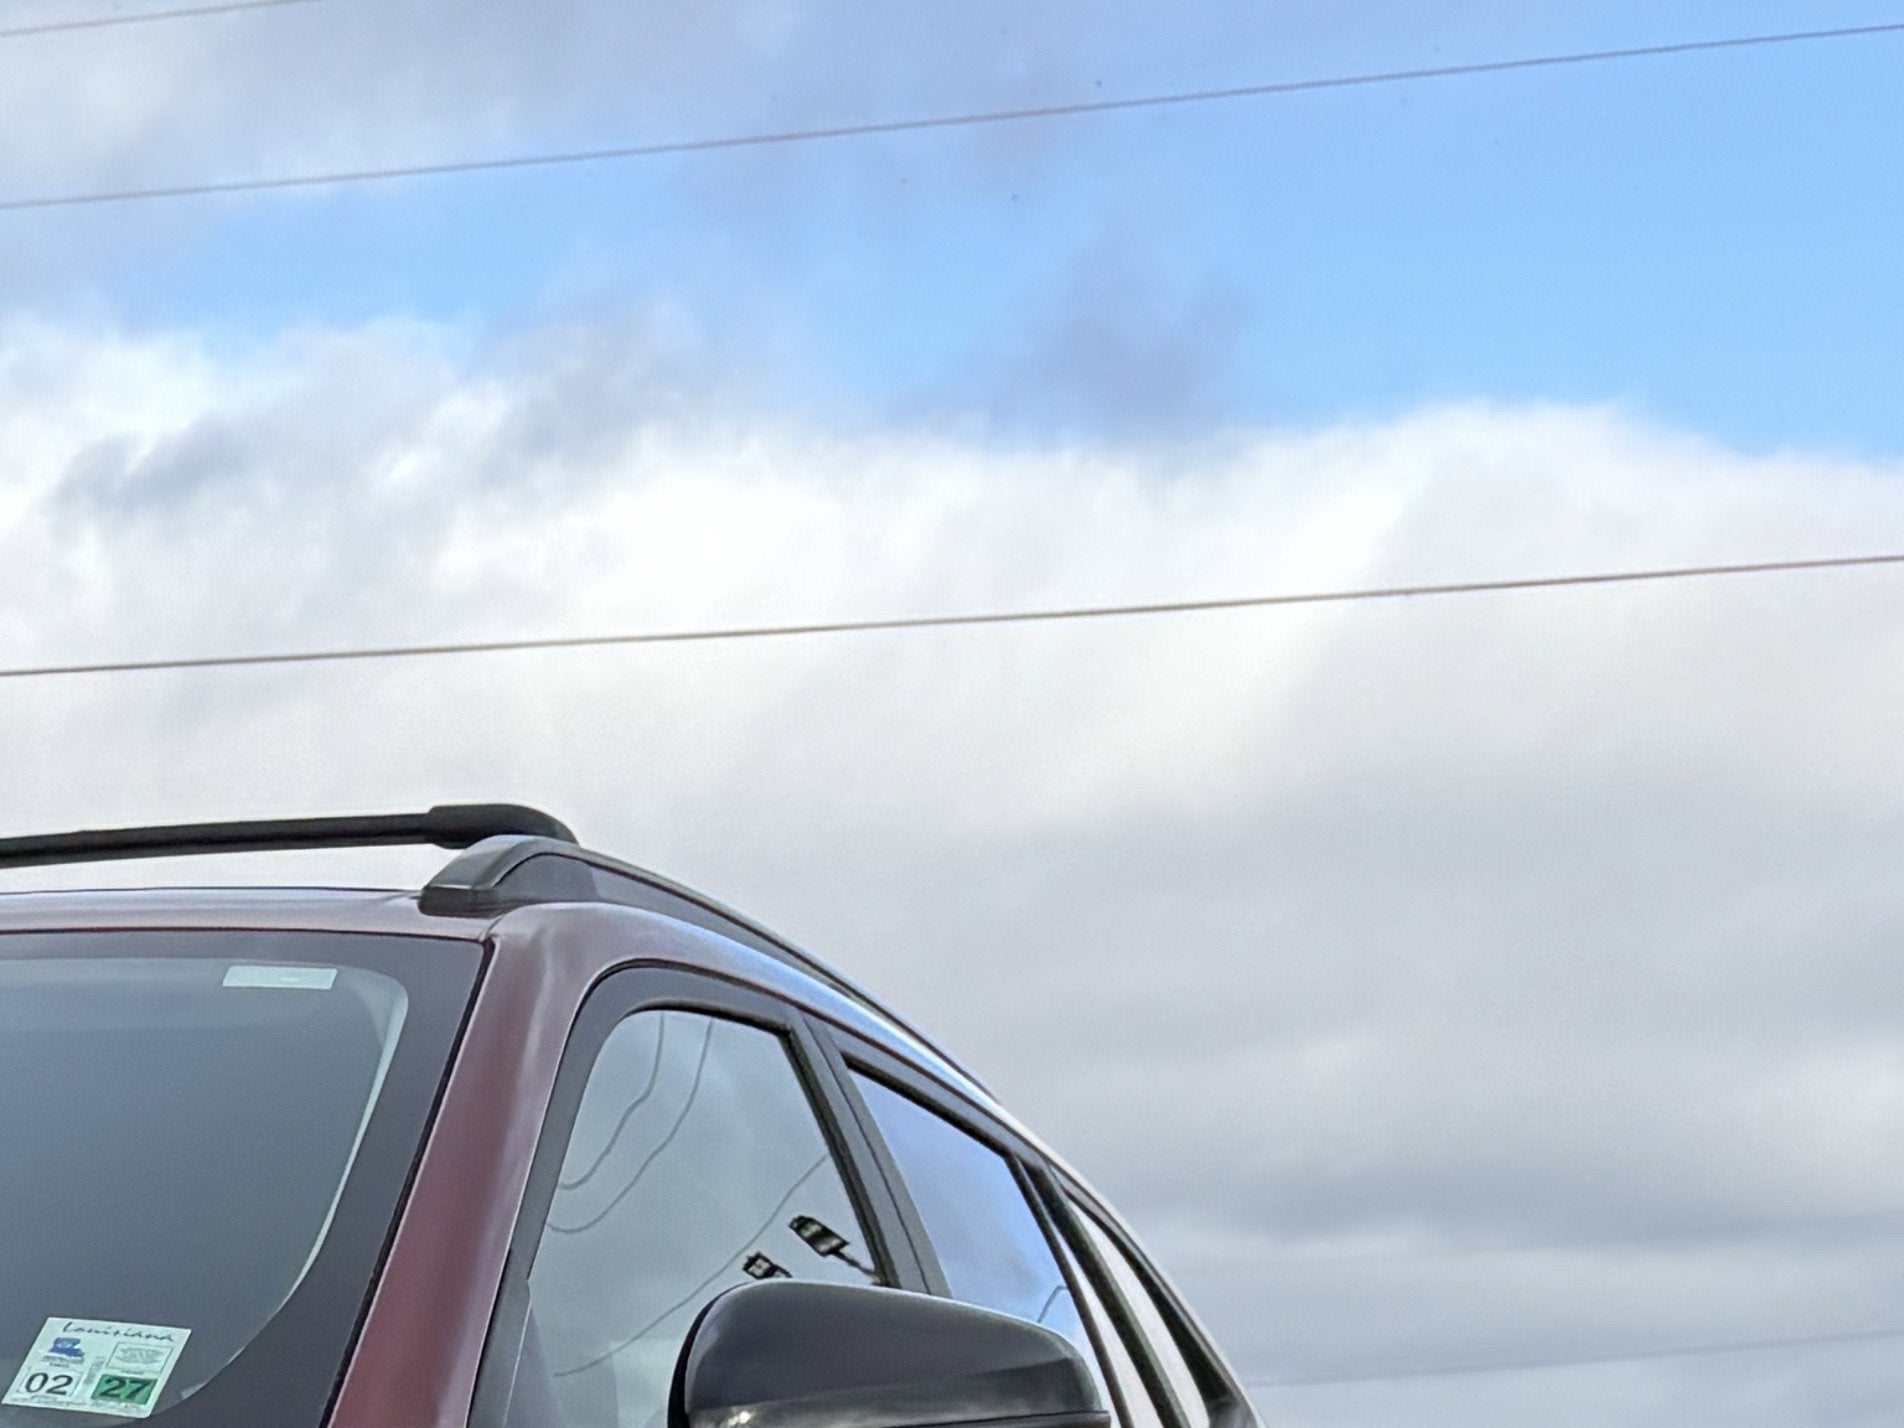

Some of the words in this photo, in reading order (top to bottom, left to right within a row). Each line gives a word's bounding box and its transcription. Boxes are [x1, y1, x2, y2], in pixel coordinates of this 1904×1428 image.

[63, 1321, 175, 1342] Louisiana
[24, 1372, 74, 1396] 02
[99, 1377, 151, 1400] 27
